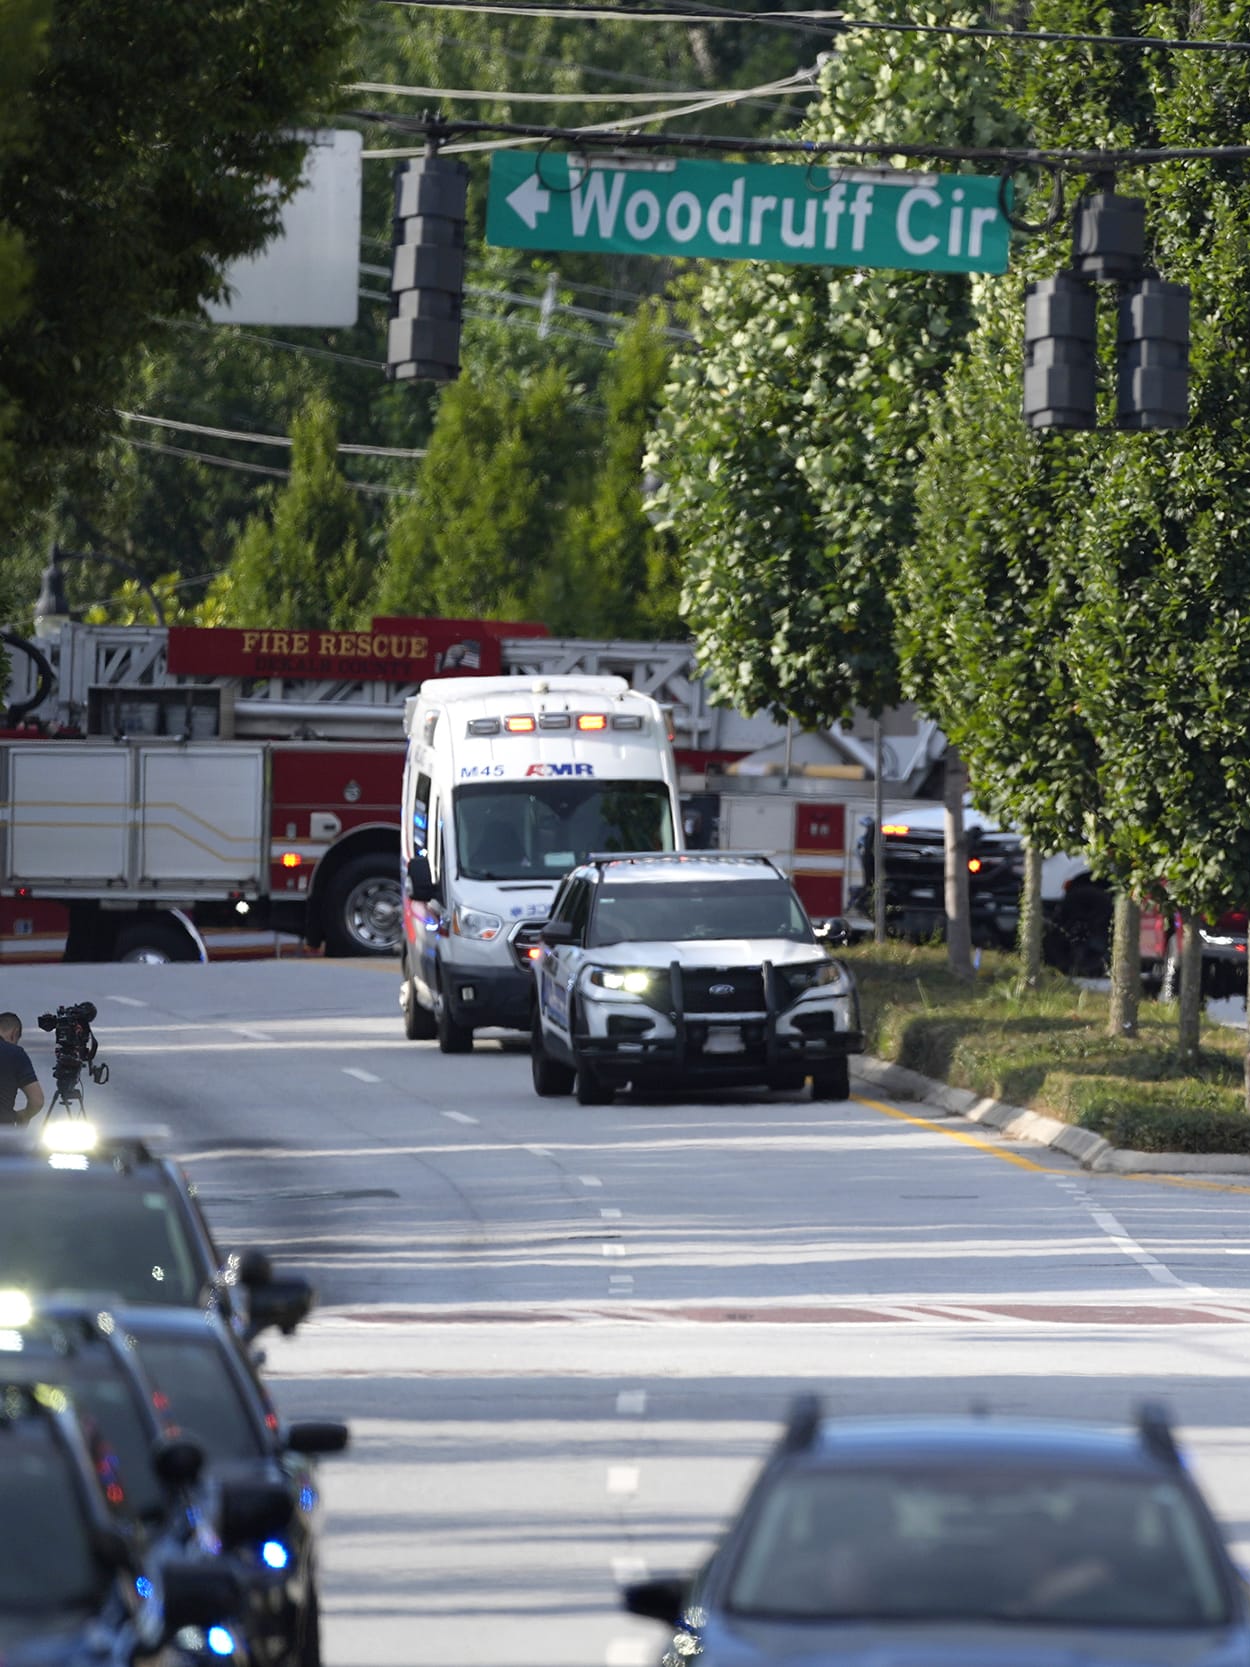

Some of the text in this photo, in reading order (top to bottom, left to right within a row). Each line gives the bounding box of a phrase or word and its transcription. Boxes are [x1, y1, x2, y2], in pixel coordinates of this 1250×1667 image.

[568, 169, 998, 257] Woodruff Cir
[242, 631, 428, 659] FIRE RESCUE
[255, 656, 412, 676] DEKALB COUNTY
[460, 764, 505, 778] M45
[525, 762, 594, 777] AMR
